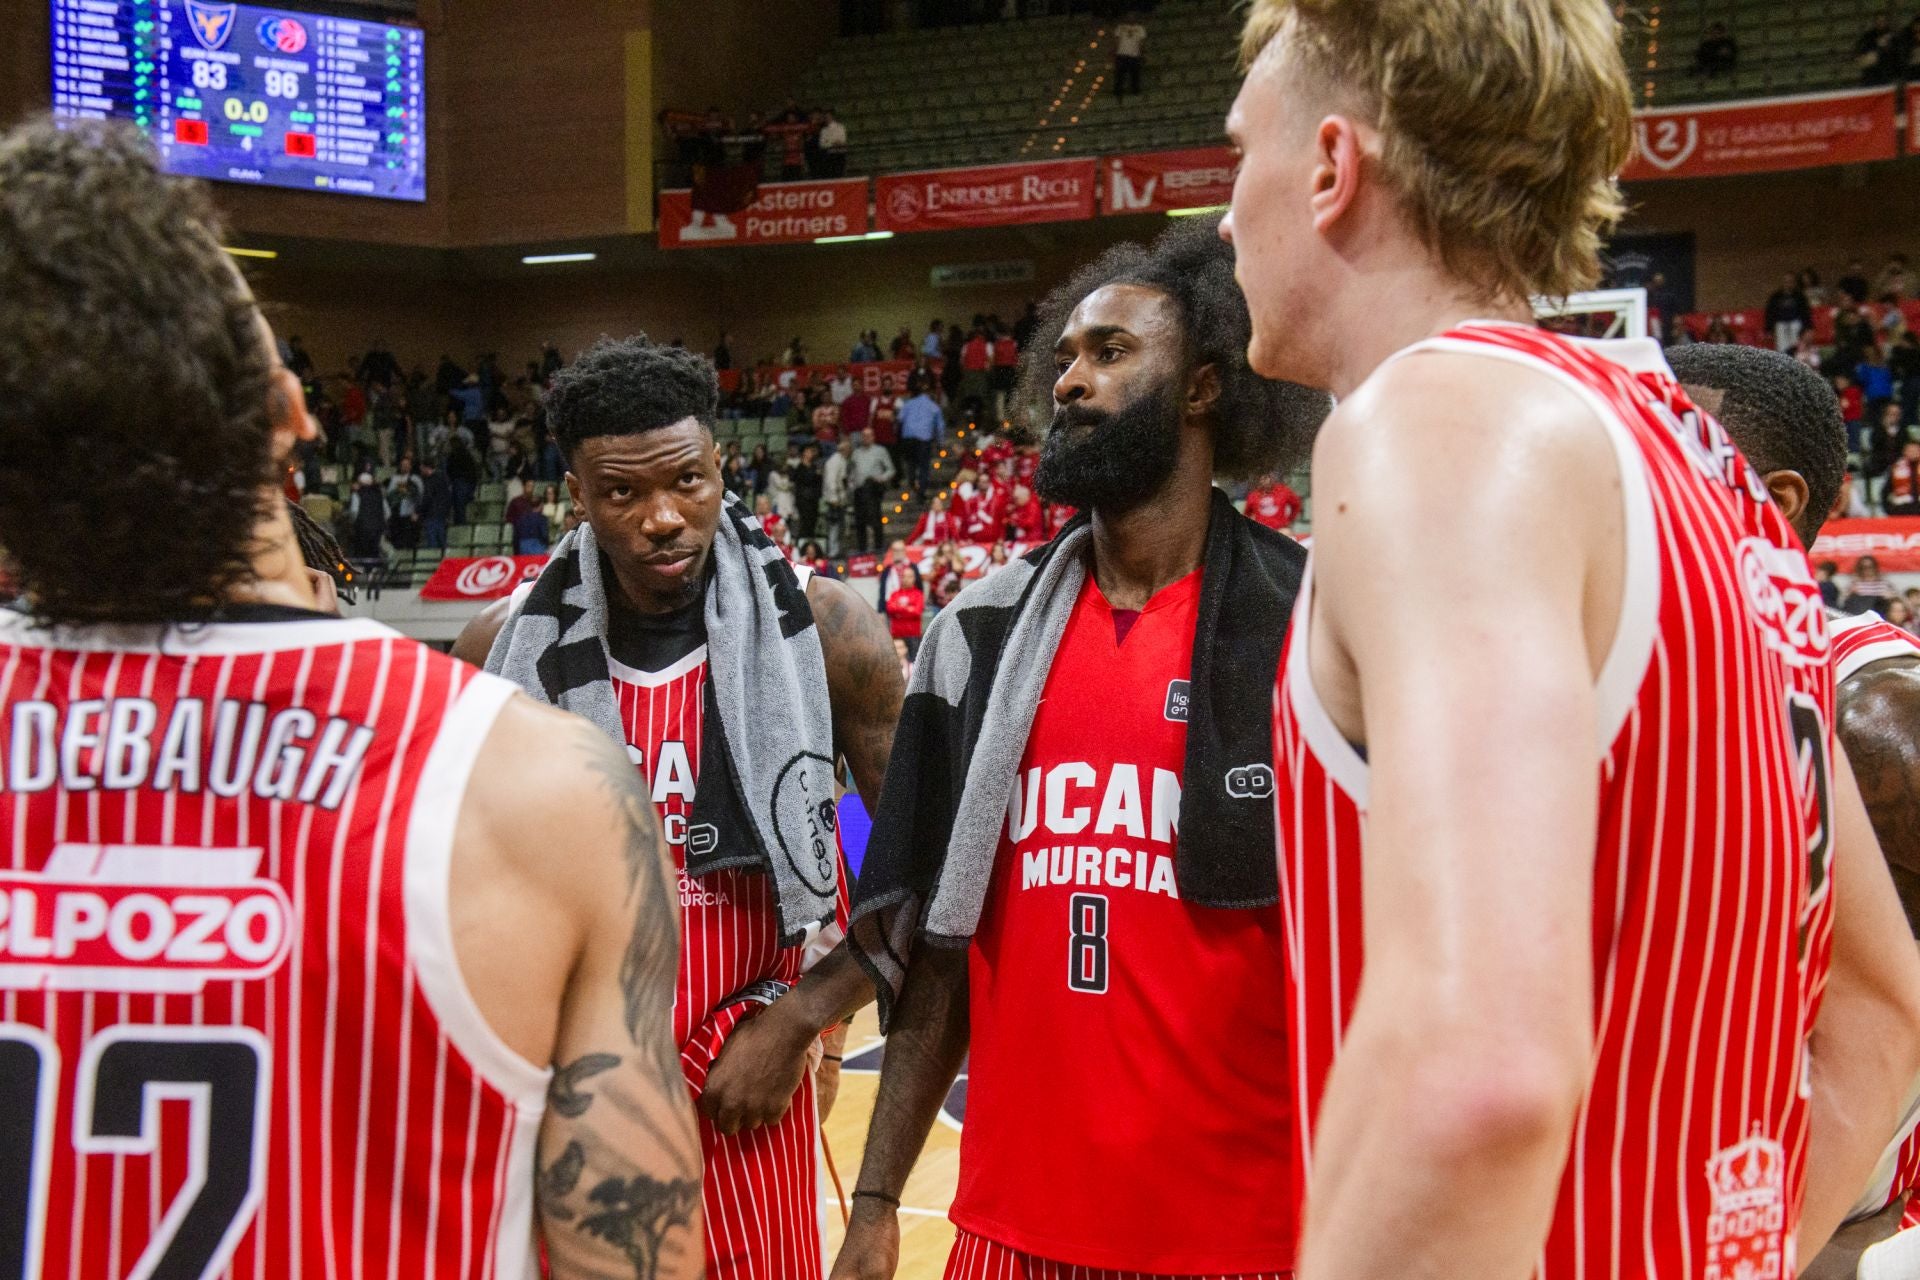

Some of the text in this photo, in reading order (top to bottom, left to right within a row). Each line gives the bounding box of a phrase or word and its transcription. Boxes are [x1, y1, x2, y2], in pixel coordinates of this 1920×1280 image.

[192, 60, 227, 90] 83
[264, 69, 299, 99] 96
[224, 97, 268, 123] 0.0
[926, 181, 1016, 210] ENRIQUE
[1022, 175, 1080, 201] RICH
[745, 215, 848, 239] Partners
[0, 696, 375, 811] DEBAUGH
[1021, 845, 1179, 900] MURCIA
[677, 891, 730, 908] URCIA
[0, 889, 283, 963] LPOZO
[1068, 891, 1109, 995] 8
